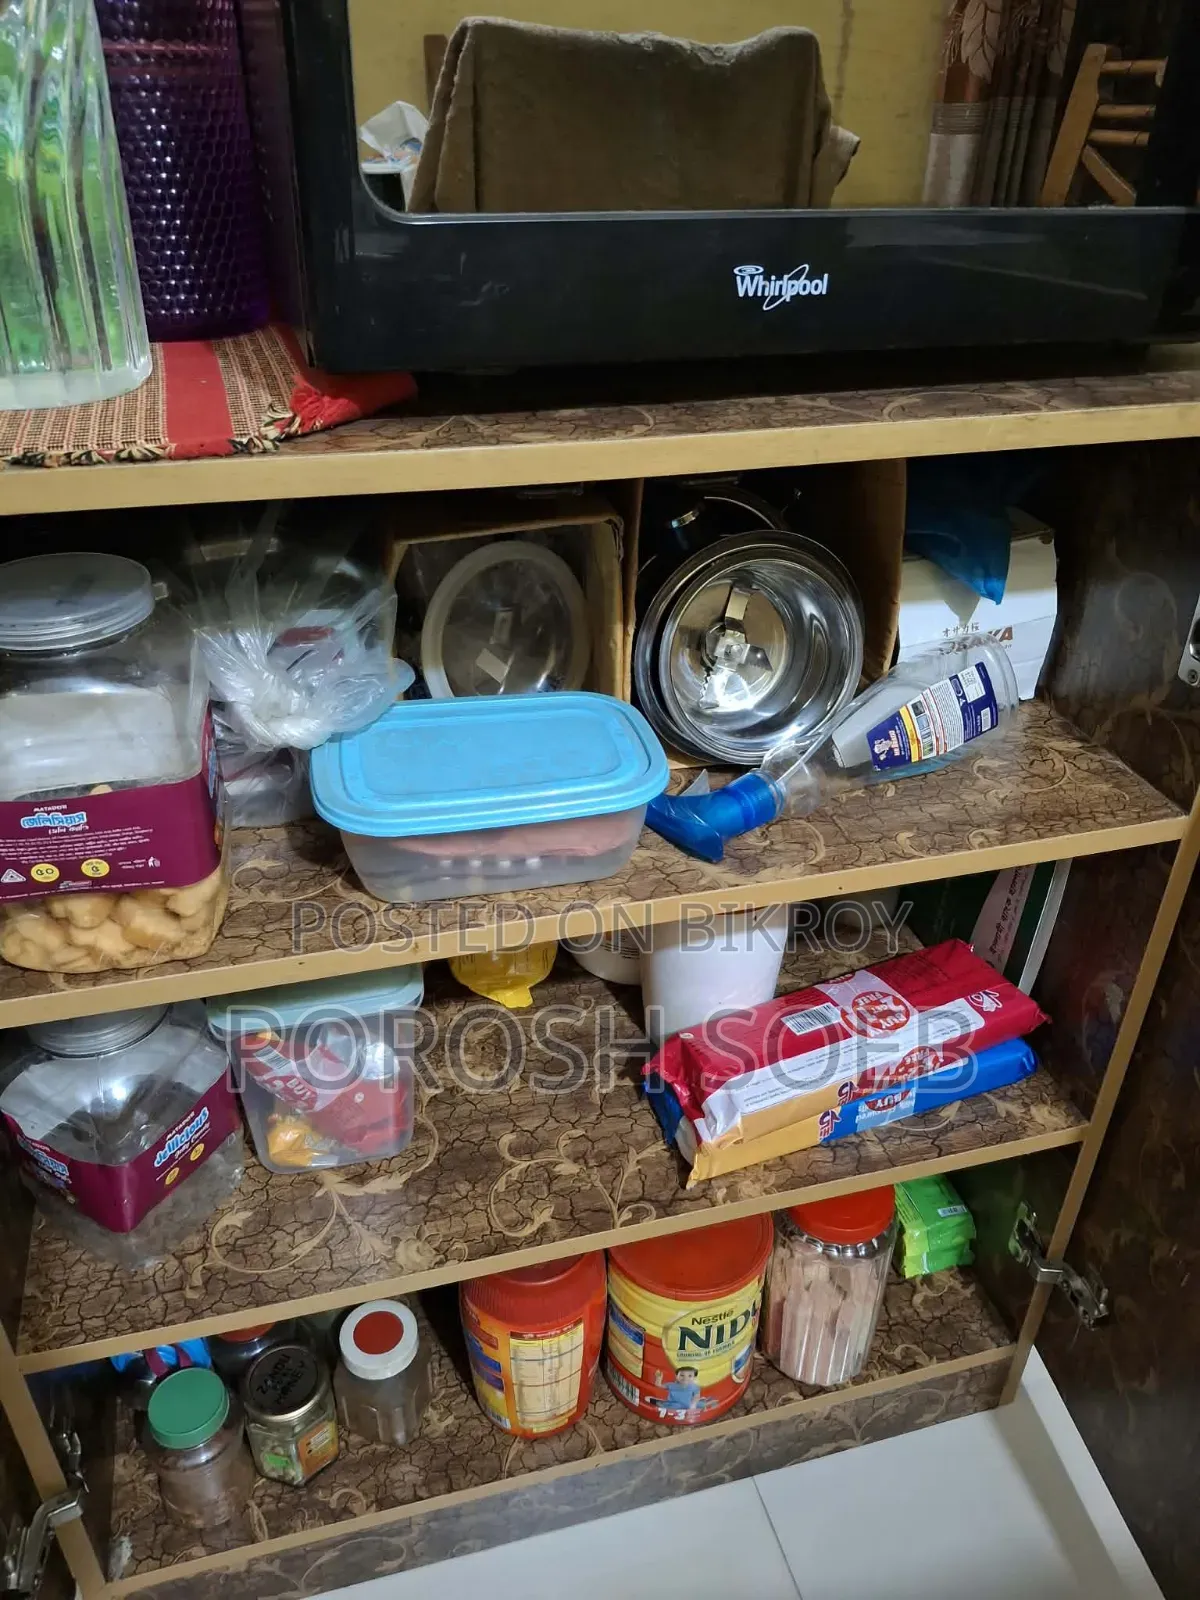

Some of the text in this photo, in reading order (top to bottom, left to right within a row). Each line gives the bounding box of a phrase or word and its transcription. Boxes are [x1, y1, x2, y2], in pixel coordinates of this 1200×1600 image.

[734, 264, 829, 310] Whirlpool
[33, 804, 68, 813] MATADOR
[879, 1013, 907, 1029] BUY
[875, 1092, 901, 1108] BUY
[154, 1107, 210, 1168] Jellicious
